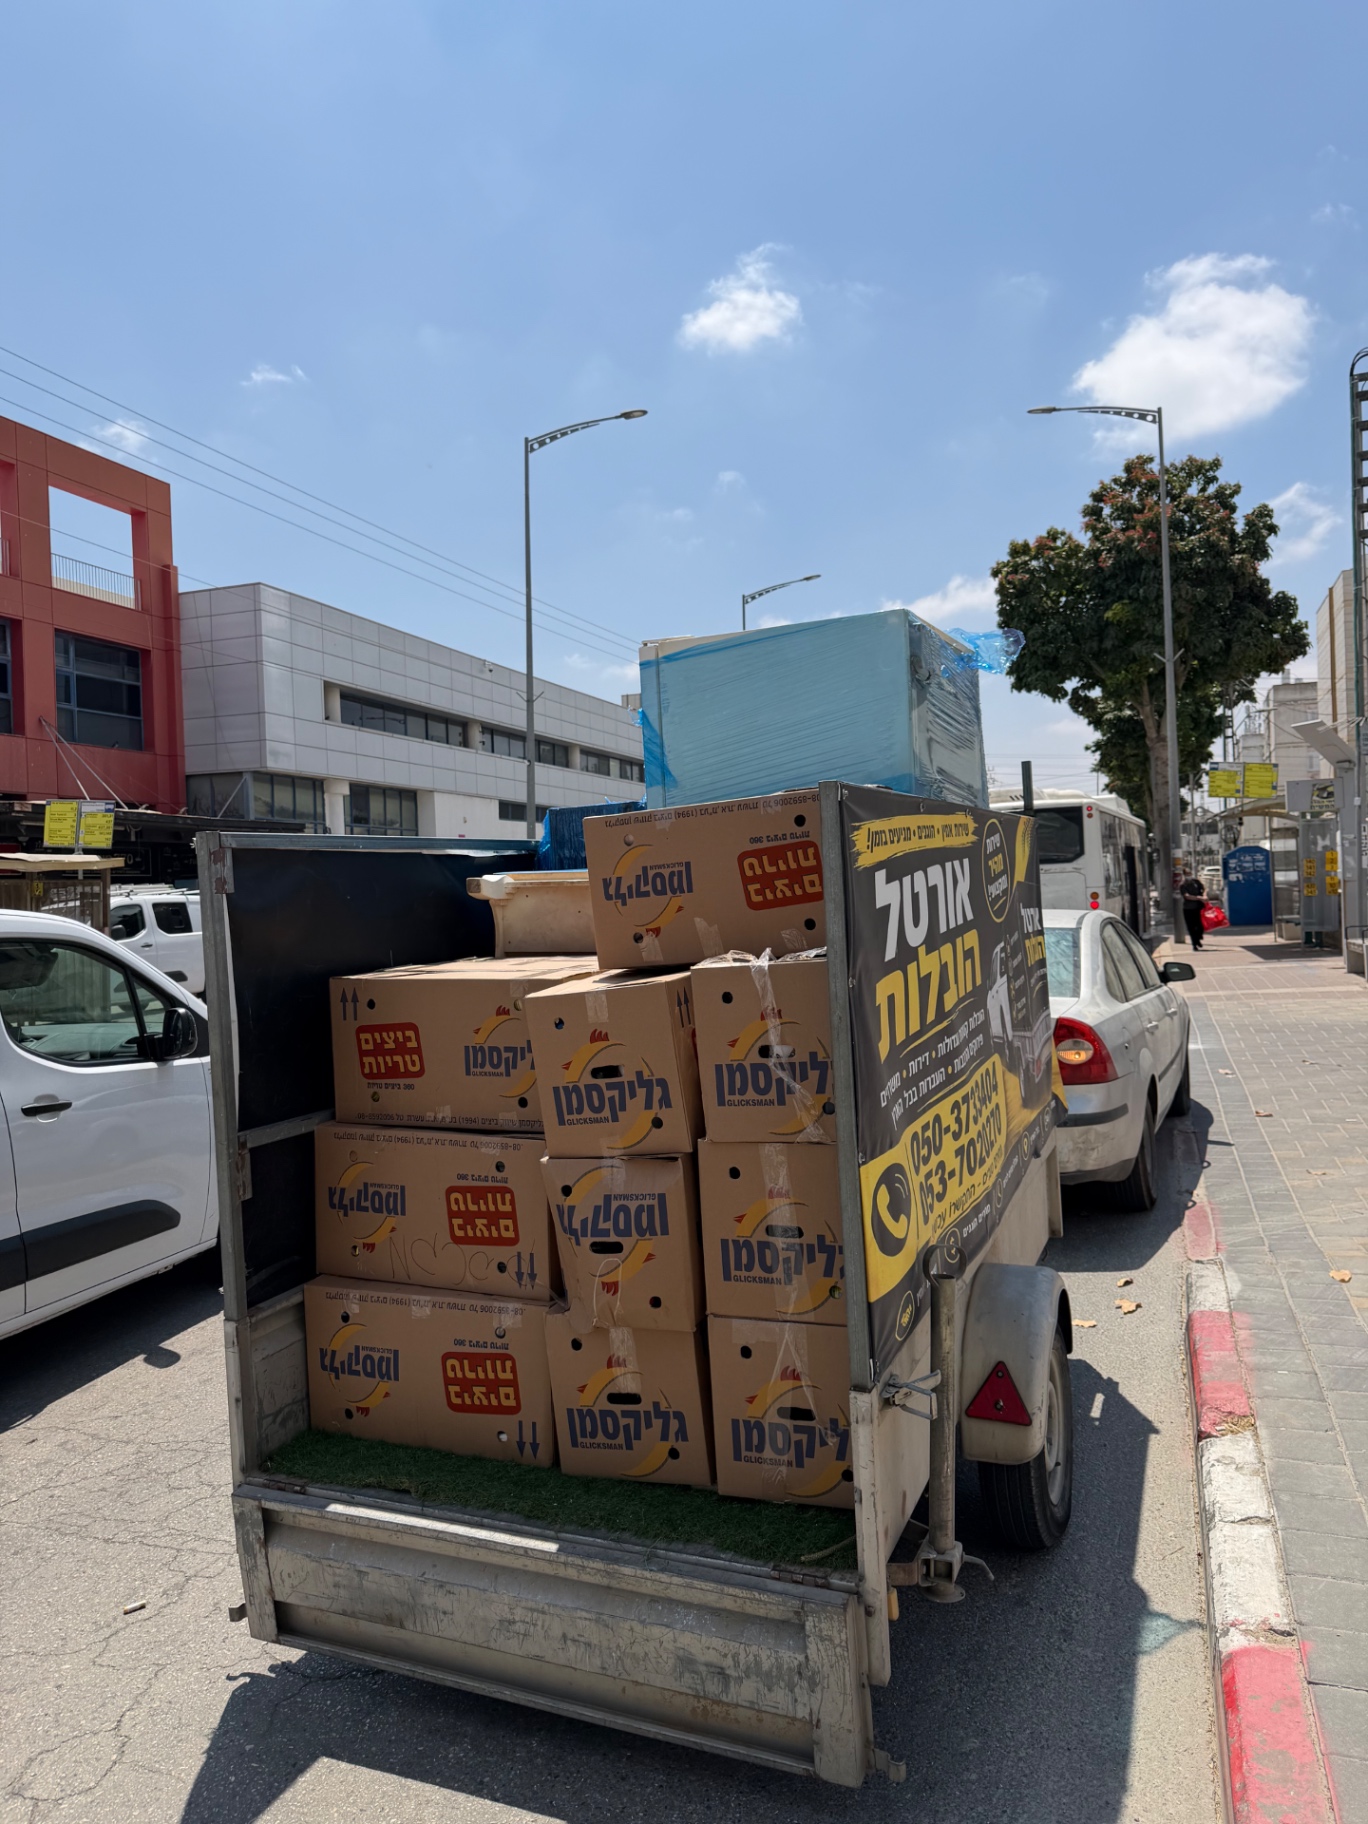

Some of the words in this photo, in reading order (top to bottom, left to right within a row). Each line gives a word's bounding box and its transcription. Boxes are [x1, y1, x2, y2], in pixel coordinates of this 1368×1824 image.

[605, 815, 632, 828] גליקסמן
[653, 812, 673, 822] ביצים
[674, 808, 697, 820] (1994)
[737, 801, 759, 811] עשרת
[766, 833, 787, 843] ביצים
[790, 830, 810, 841] טריות
[866, 827, 888, 853] בזמן!
[649, 862, 684, 871] GLICKSMAN
[742, 847, 817, 877] טריות
[602, 861, 694, 906] גליקסמן
[747, 873, 823, 903] ביצים
[874, 858, 975, 962] אורטל
[875, 929, 982, 1064] הובלות
[359, 1029, 419, 1050] ביצים
[362, 1054, 422, 1074] טריות
[464, 1039, 535, 1077] ליקסמן
[909, 1051, 929, 1077] דירות
[714, 1052, 834, 1107] ליקסמן
[918, 1067, 945, 1097] העברות
[552, 1070, 673, 1126] גליקסמן
[727, 1098, 775, 1107] GLICKSMAN
[903, 1086, 918, 1108] בכל
[458, 1115, 479, 1126] (1994)
[566, 1116, 610, 1126] GLICKSMAN
[910, 1061, 998, 1176] 050-3733404
[394, 1135, 415, 1145] (1994)
[919, 1102, 1002, 1226] 053-7020270
[328, 1181, 406, 1217] גליקסמן
[450, 1192, 513, 1212] טריות
[613, 1193, 657, 1201] GLICKSMAN
[452, 1218, 515, 1238] ביצים
[556, 1193, 669, 1246] גליקסמן
[733, 1275, 782, 1285] GLICKSMAN
[389, 1297, 411, 1307] (1994)
[446, 1302, 466, 1311] עשרת
[361, 1345, 393, 1354] GLICKSMAN
[469, 1340, 488, 1348] ביצים
[490, 1342, 509, 1350] טריות
[319, 1345, 399, 1381] גליקסמן
[446, 1359, 514, 1380] טריות
[448, 1385, 516, 1406] ביצים
[566, 1401, 689, 1451] גליקסמן
[579, 1441, 624, 1451] GLICKSMAN
[731, 1417, 849, 1469] ליקסמן
[743, 1454, 793, 1468] GLICKSMAN
